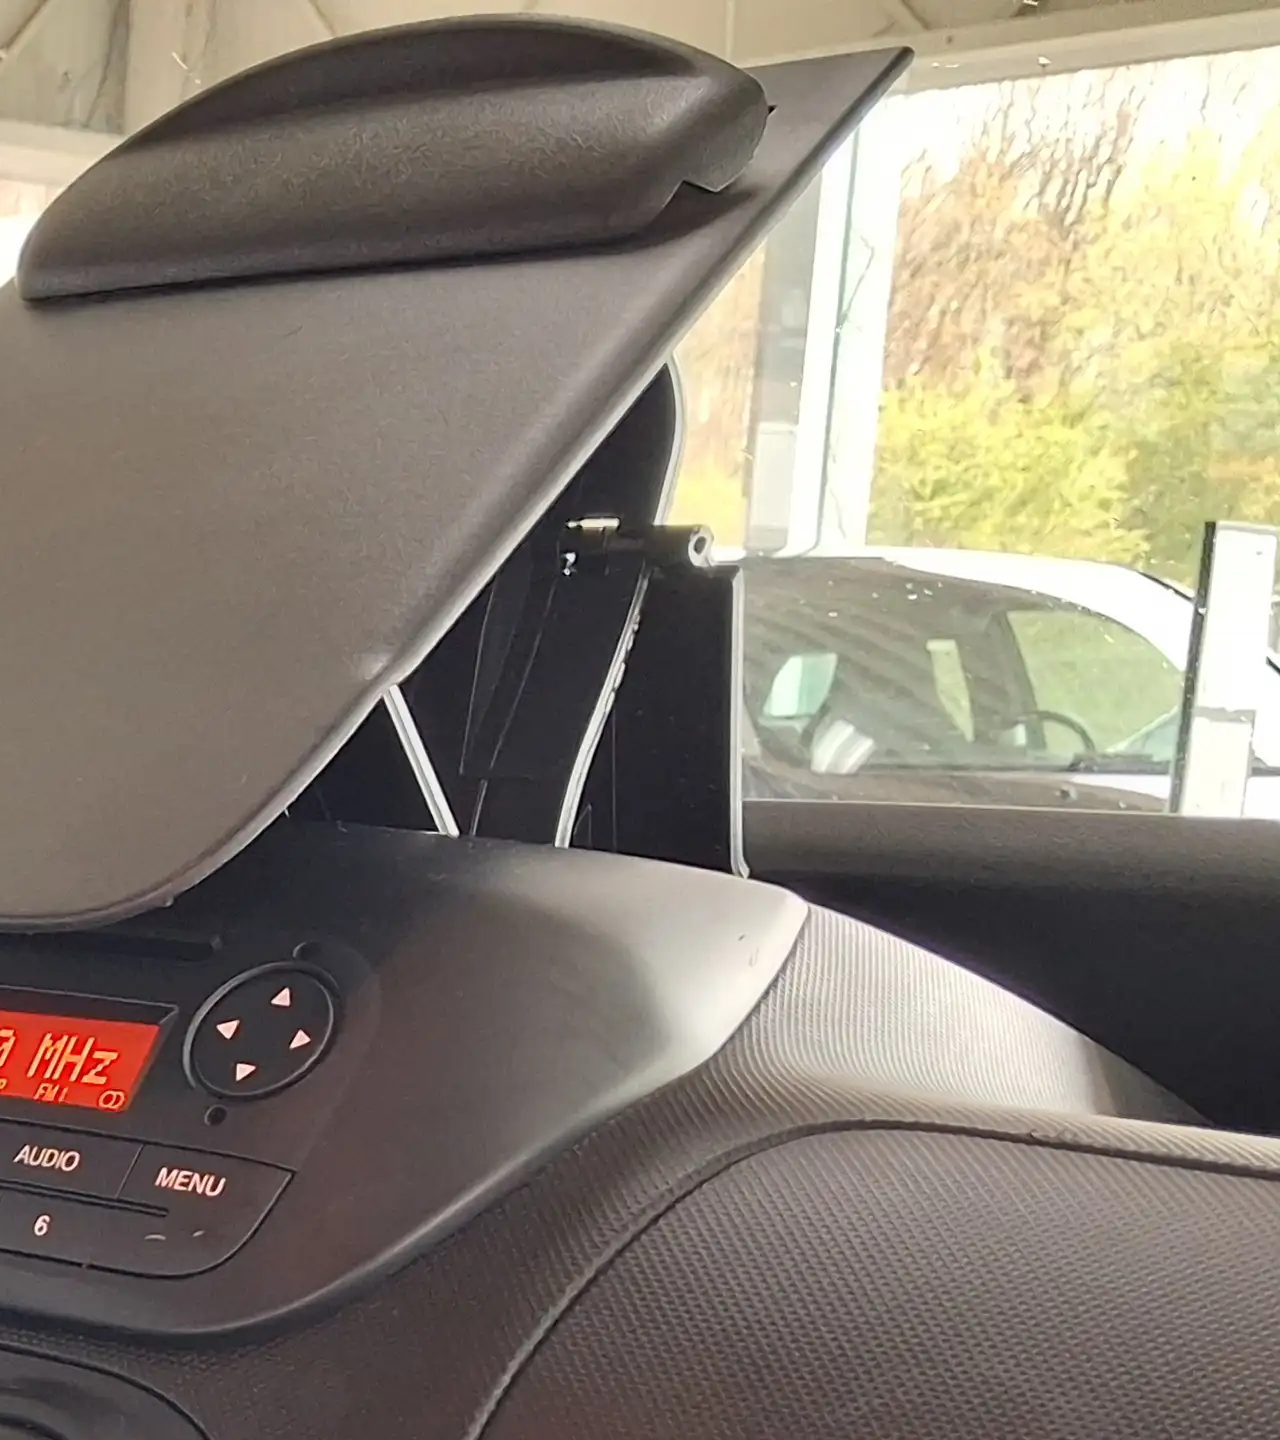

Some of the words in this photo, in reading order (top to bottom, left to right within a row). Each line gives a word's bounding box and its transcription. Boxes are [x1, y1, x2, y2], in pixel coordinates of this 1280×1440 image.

[26, 1031, 119, 1085] MHz
[13, 1144, 81, 1172] AUDIO
[154, 1166, 227, 1197] MENU
[33, 1214, 51, 1236] 6
